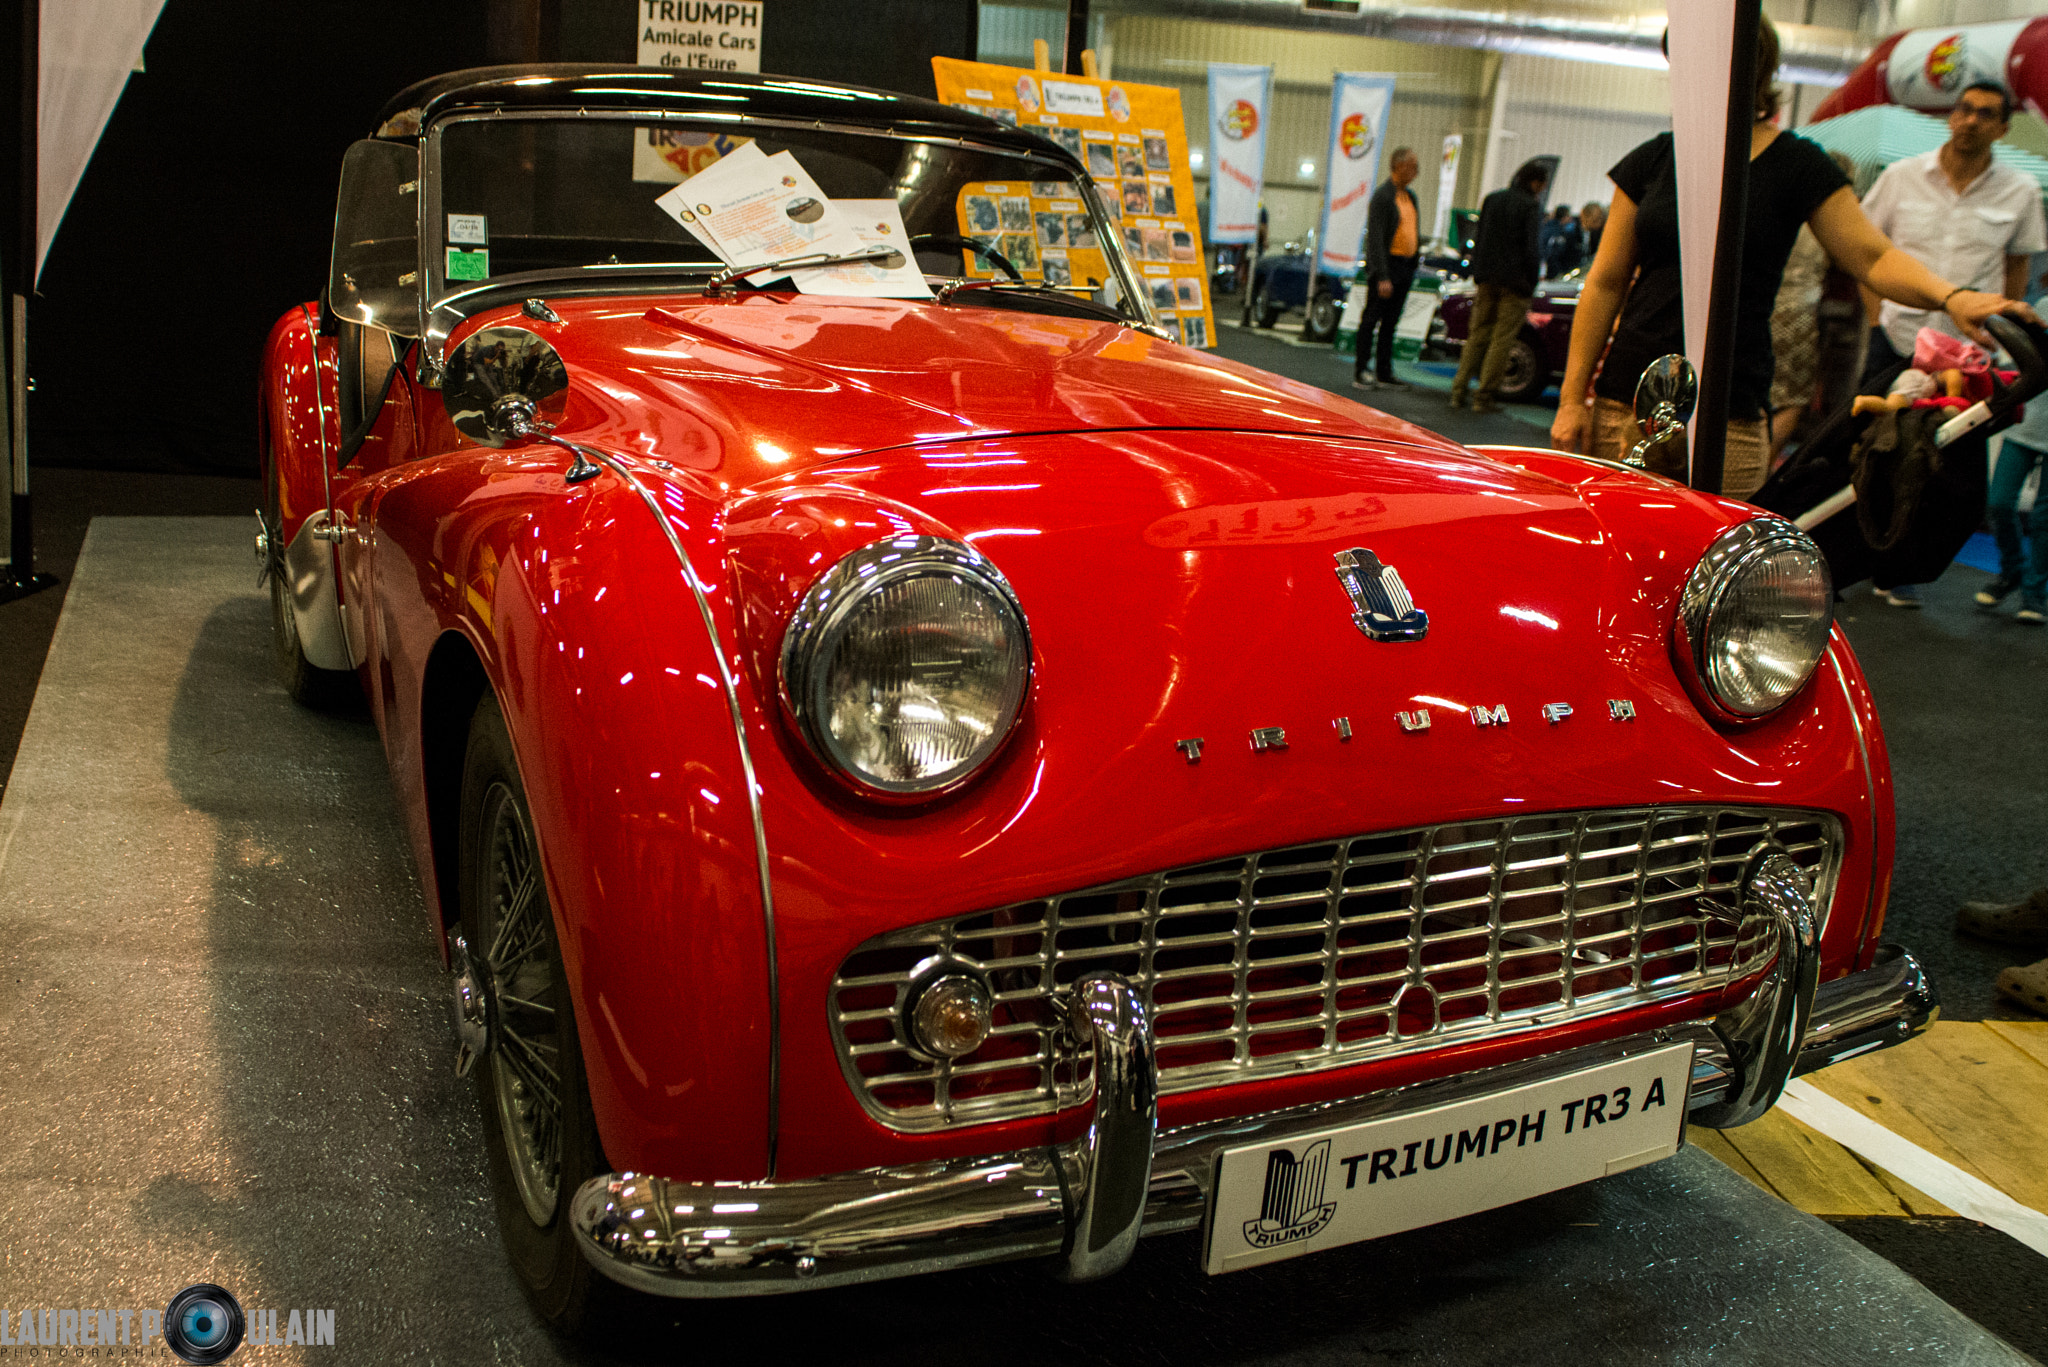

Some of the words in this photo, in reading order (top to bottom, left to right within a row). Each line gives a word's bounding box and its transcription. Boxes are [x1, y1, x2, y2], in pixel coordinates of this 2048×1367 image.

[644, 0, 757, 26] TRIUMPH
[643, 26, 713, 48] Amicale
[719, 32, 756, 50] Cars
[660, 52, 681, 66] de
[688, 53, 737, 70] l'Eure
[1175, 699, 1636, 765] TRIUMPH
[1340, 1109, 1546, 1189] TRIUMPH
[1561, 1086, 1632, 1134] TR3
[1640, 1077, 1666, 1112] A
